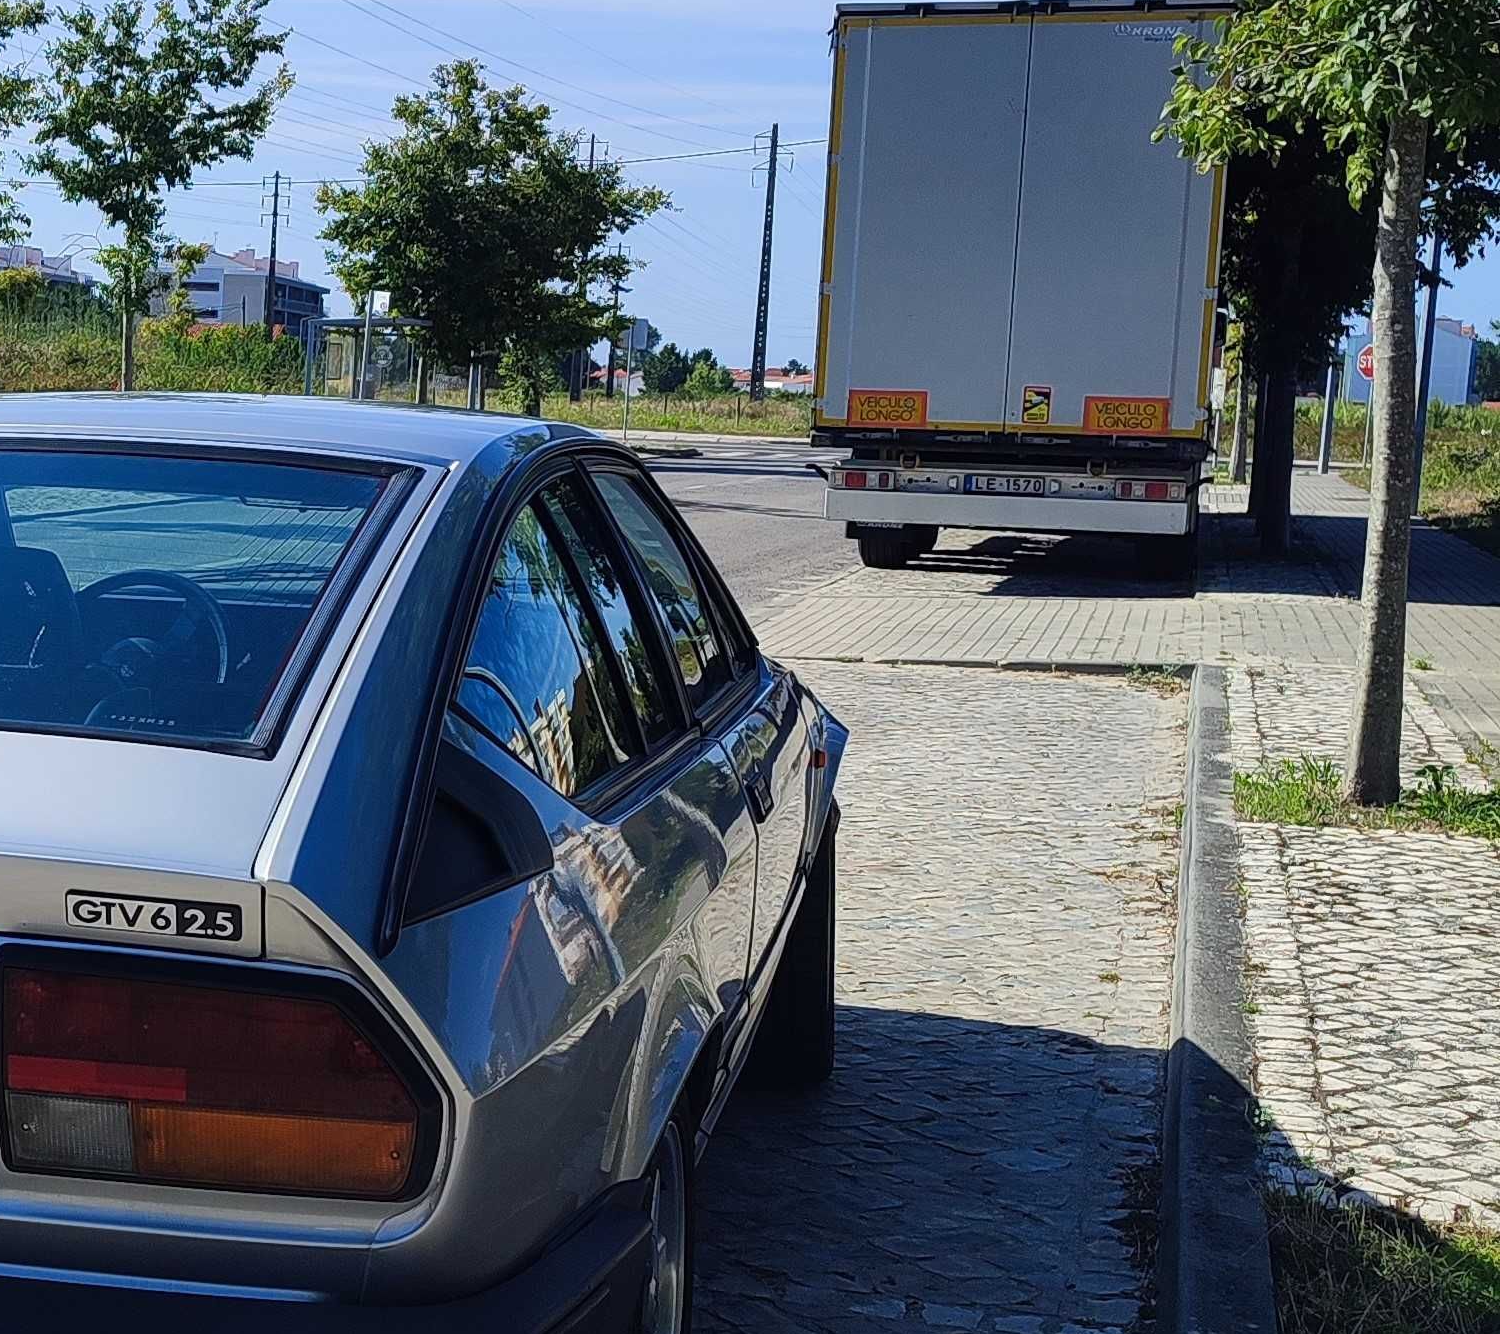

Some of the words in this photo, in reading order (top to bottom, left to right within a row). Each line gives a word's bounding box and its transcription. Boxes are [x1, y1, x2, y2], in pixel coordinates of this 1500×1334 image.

[858, 395, 916, 409] VEICULO
[1094, 402, 1157, 416] VEICULO
[859, 408, 913, 422] LONGO
[1097, 416, 1153, 429] LONGO
[183, 908, 235, 937] 2.5
